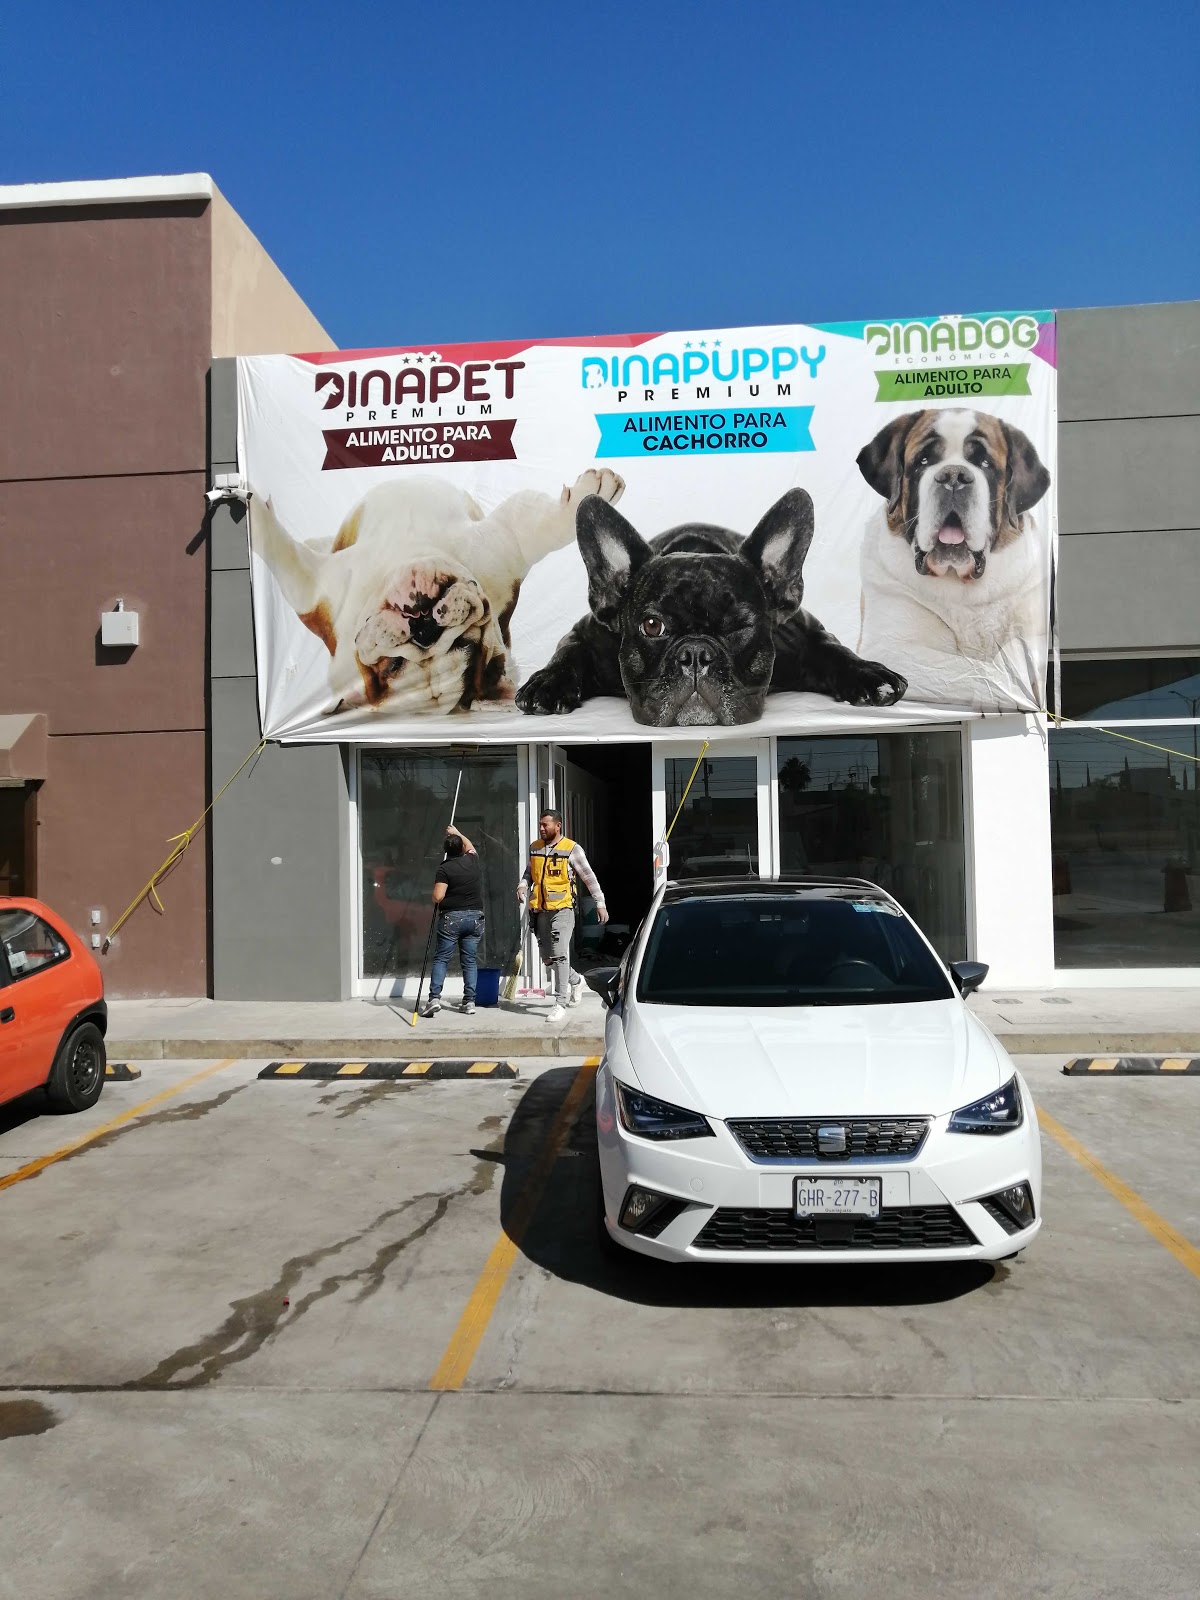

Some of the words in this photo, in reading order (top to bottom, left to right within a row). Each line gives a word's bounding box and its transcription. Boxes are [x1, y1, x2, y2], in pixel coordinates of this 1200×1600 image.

[866, 318, 1038, 355] DINADOG
[581, 344, 826, 389] DINAPUPPY
[894, 352, 1010, 365] ECONÓMICA
[894, 369, 968, 384] ALIMENTO
[973, 367, 1012, 380] PARA
[314, 361, 526, 410] DINAPET
[618, 384, 791, 402] PREMIUM
[923, 382, 983, 397] ADULTO
[346, 404, 492, 422] PREMIUM
[623, 413, 726, 433] ALIMENTO
[733, 412, 787, 429] PARA
[345, 430, 438, 448] ALIMENTO
[443, 425, 492, 441] PARA
[642, 432, 768, 452] CACHORRO
[381, 444, 455, 463] ADULTO
[798, 1189, 878, 1207] GHR-277-B
